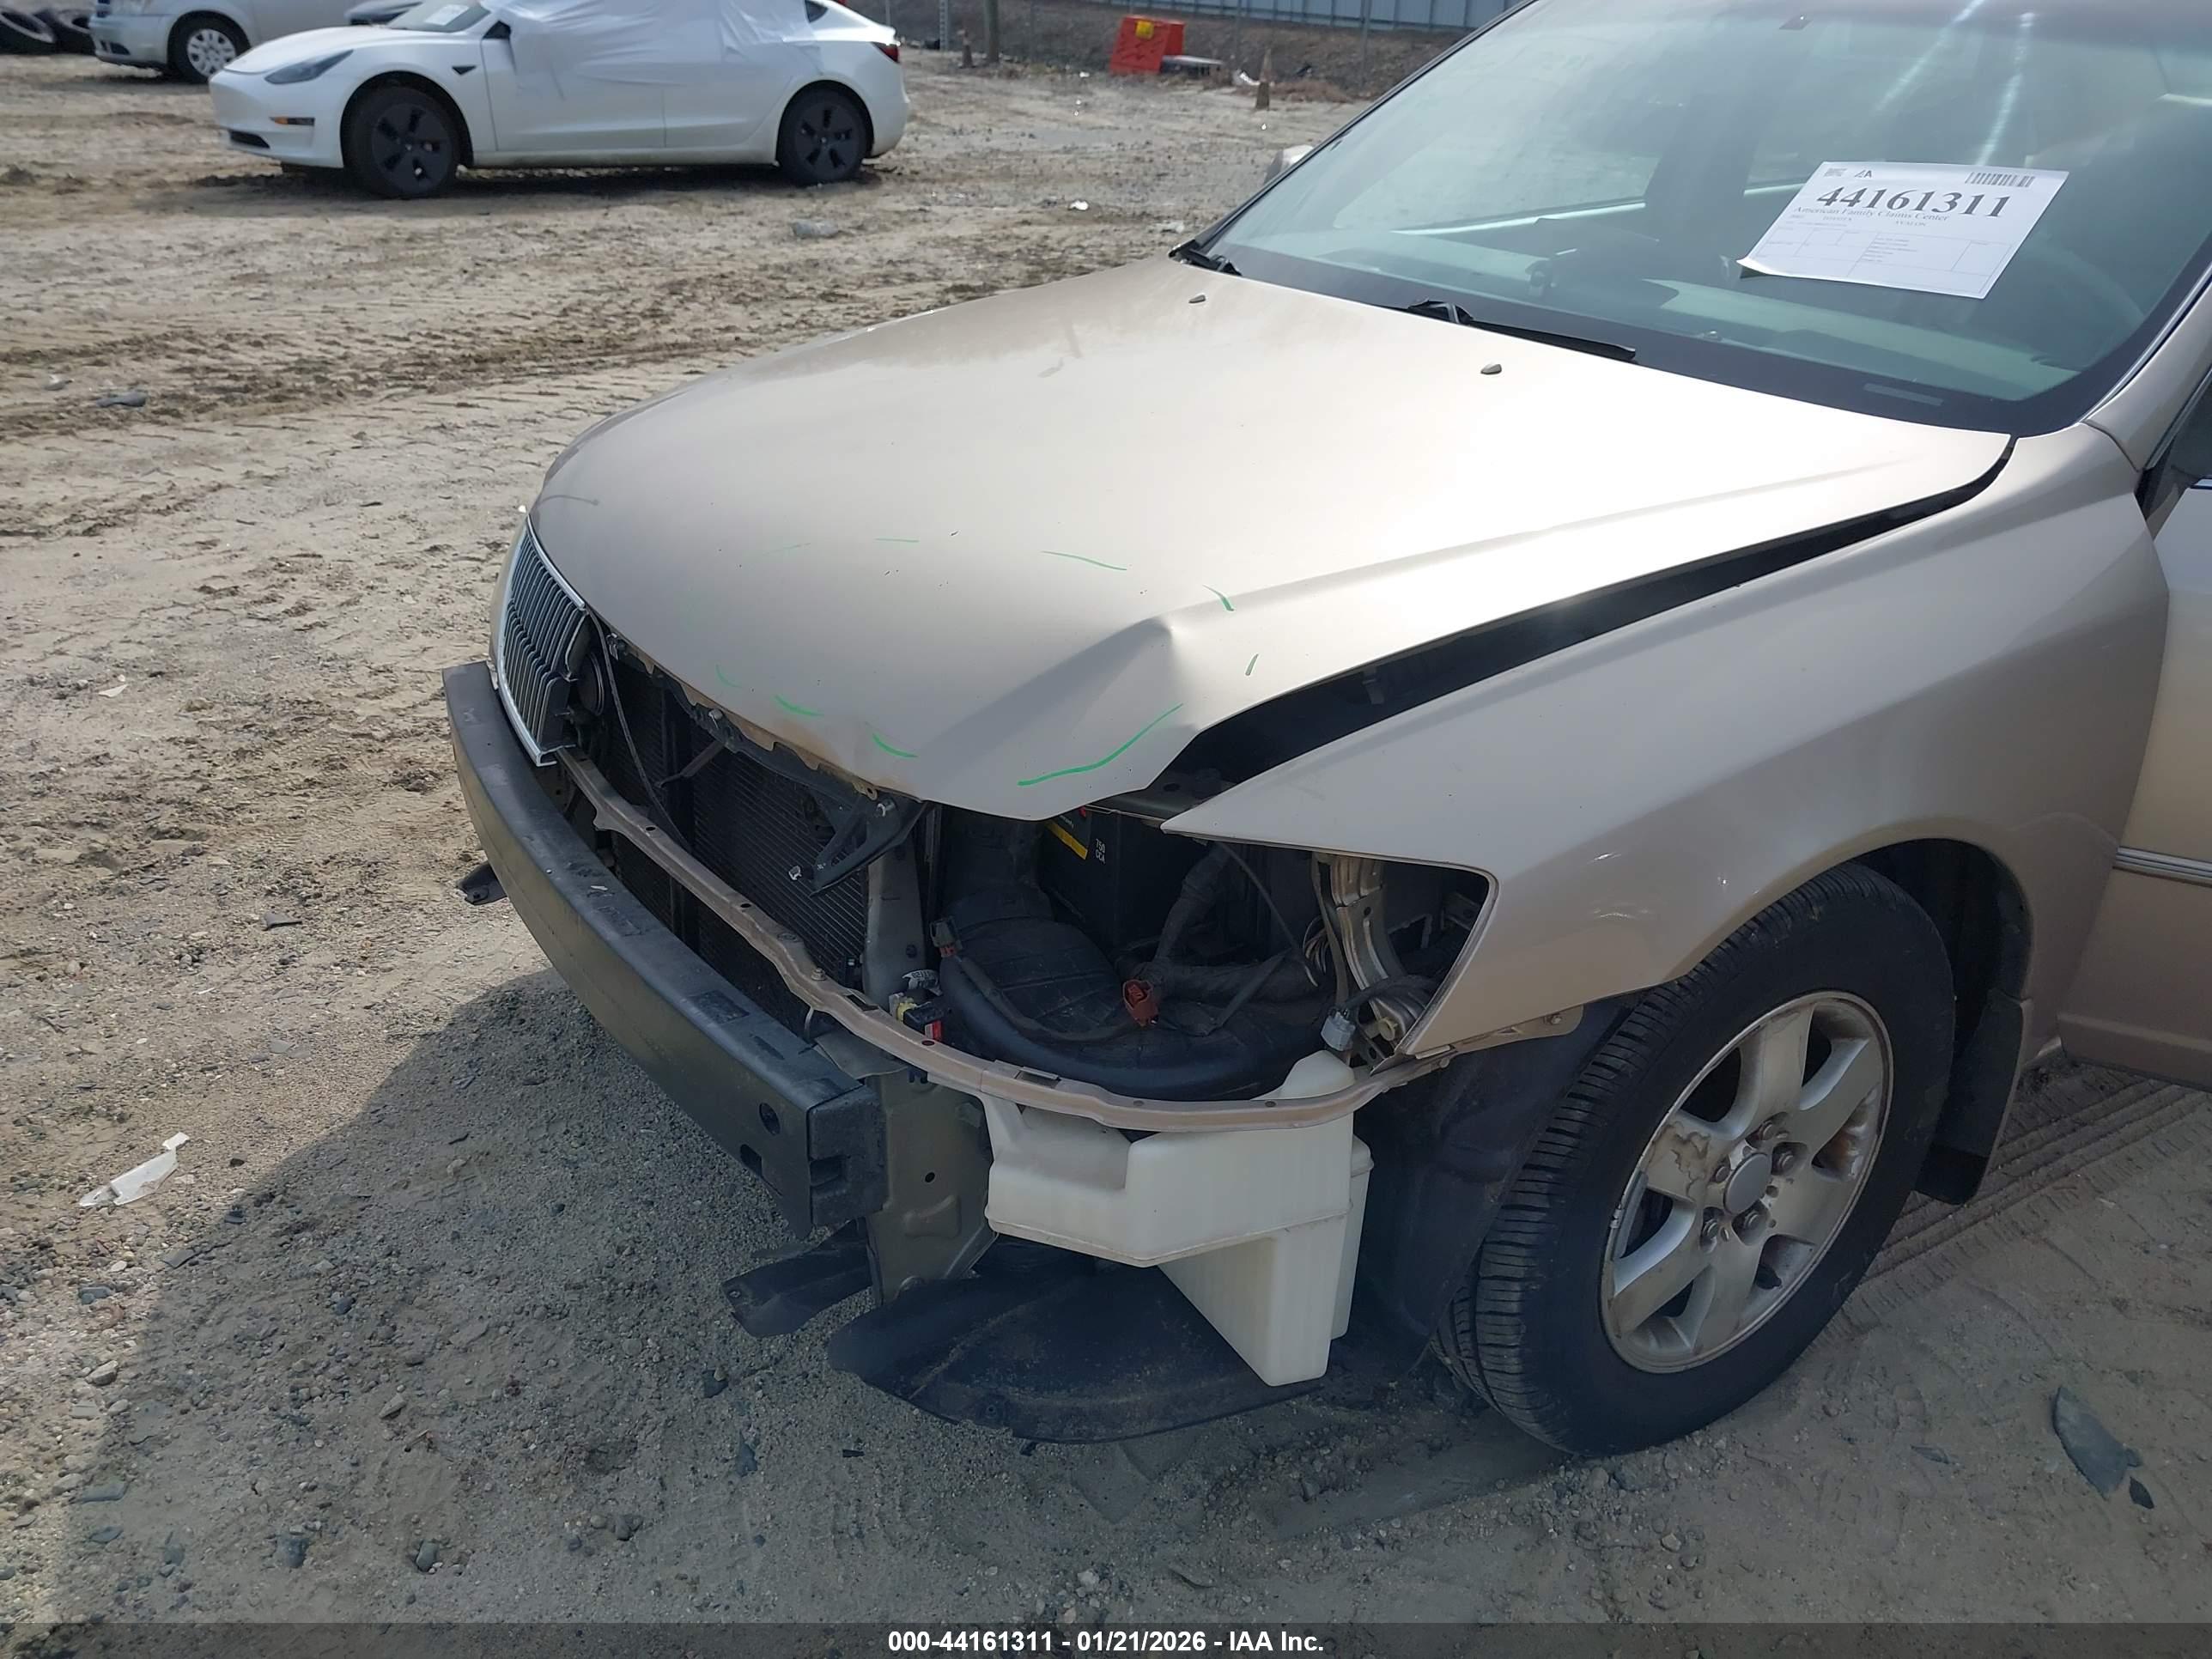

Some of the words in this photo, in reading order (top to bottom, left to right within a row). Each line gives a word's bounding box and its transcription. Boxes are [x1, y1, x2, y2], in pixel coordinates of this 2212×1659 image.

[1816, 186, 2011, 217] 44161311
[1794, 206, 1839, 216] American
[1842, 209, 1873, 217] Family
[1877, 210, 1913, 219] Claims
[1915, 212, 1950, 222] Center
